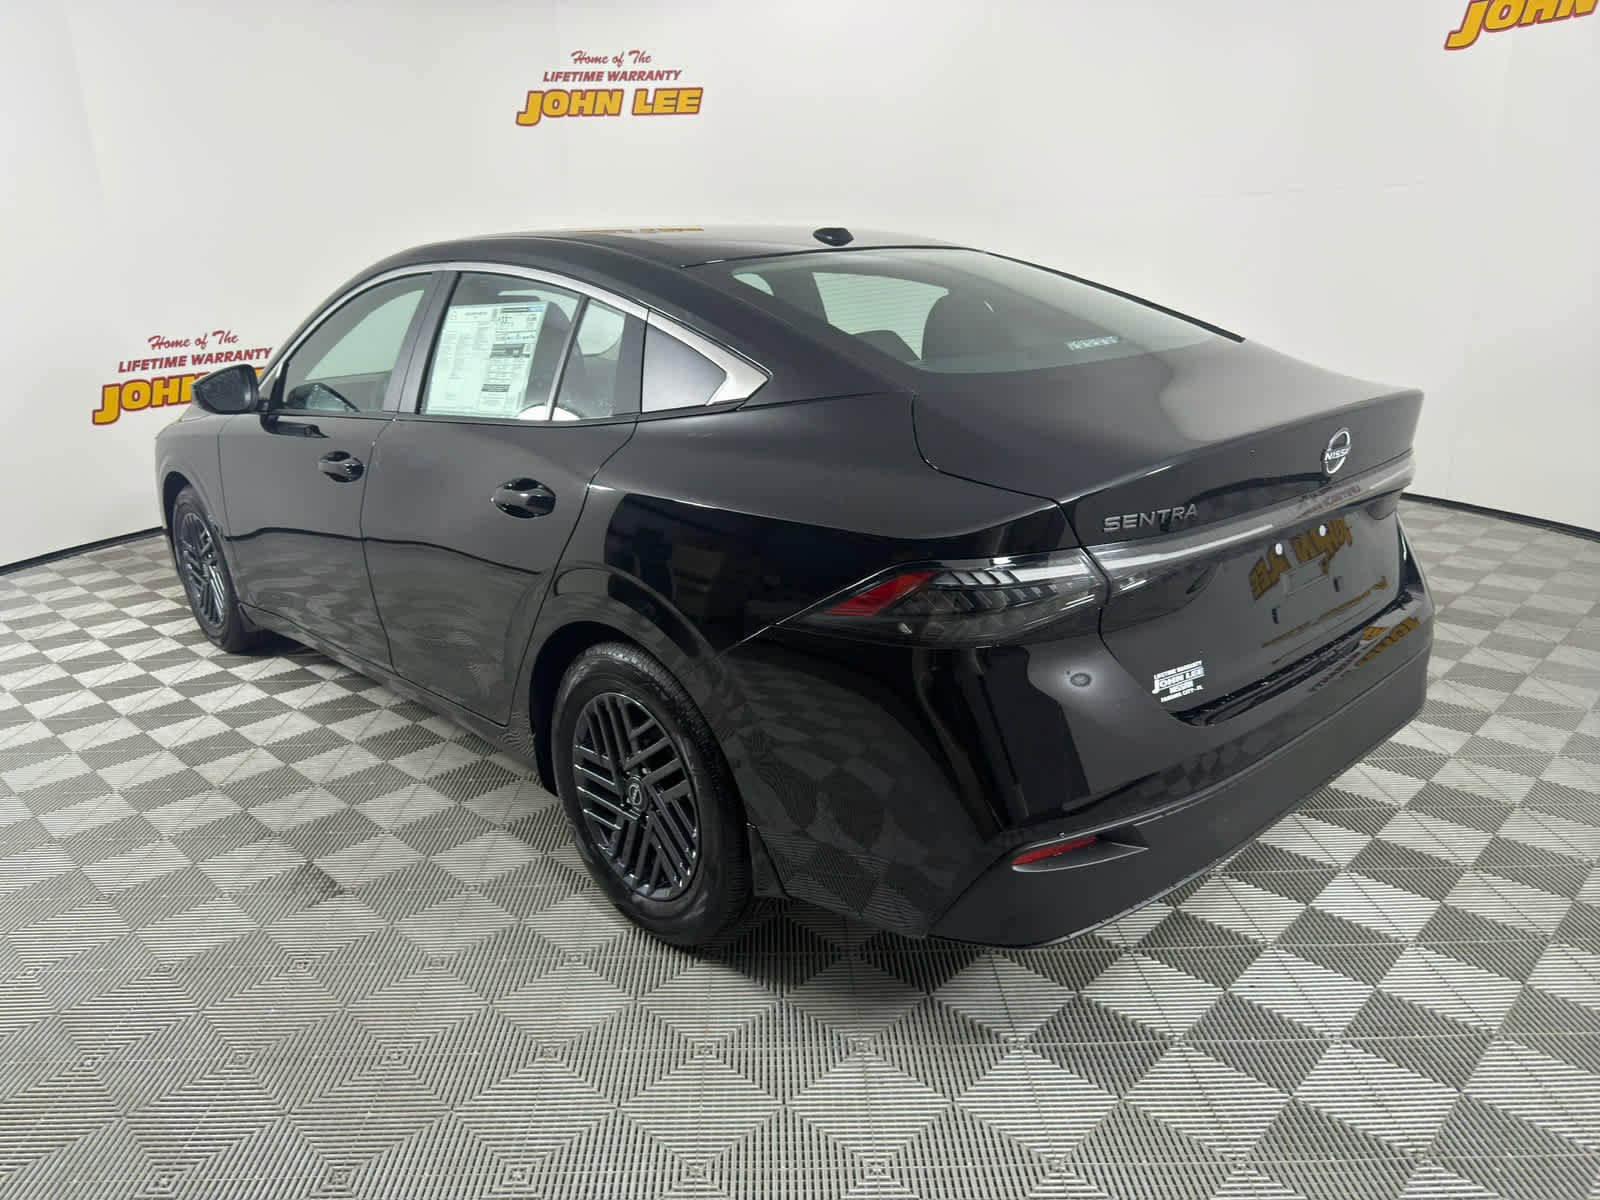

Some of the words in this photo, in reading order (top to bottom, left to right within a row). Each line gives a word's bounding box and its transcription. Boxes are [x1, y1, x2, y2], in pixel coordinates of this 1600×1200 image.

[571, 50, 609, 64] Home
[612, 52, 625, 67] of
[628, 50, 652, 64] The
[543, 71, 604, 82] LIFETIME
[607, 70, 682, 82] WARRANTY
[516, 88, 625, 126] JOHN
[631, 87, 704, 116] LEE
[147, 335, 191, 350] Home
[194, 333, 208, 350] of
[212, 330, 239, 345] The
[118, 355, 188, 373] LIFETIME
[191, 347, 272, 366] WARRANTY
[1103, 503, 1198, 533] SENTRA
[1152, 674, 1185, 694] JOHN
